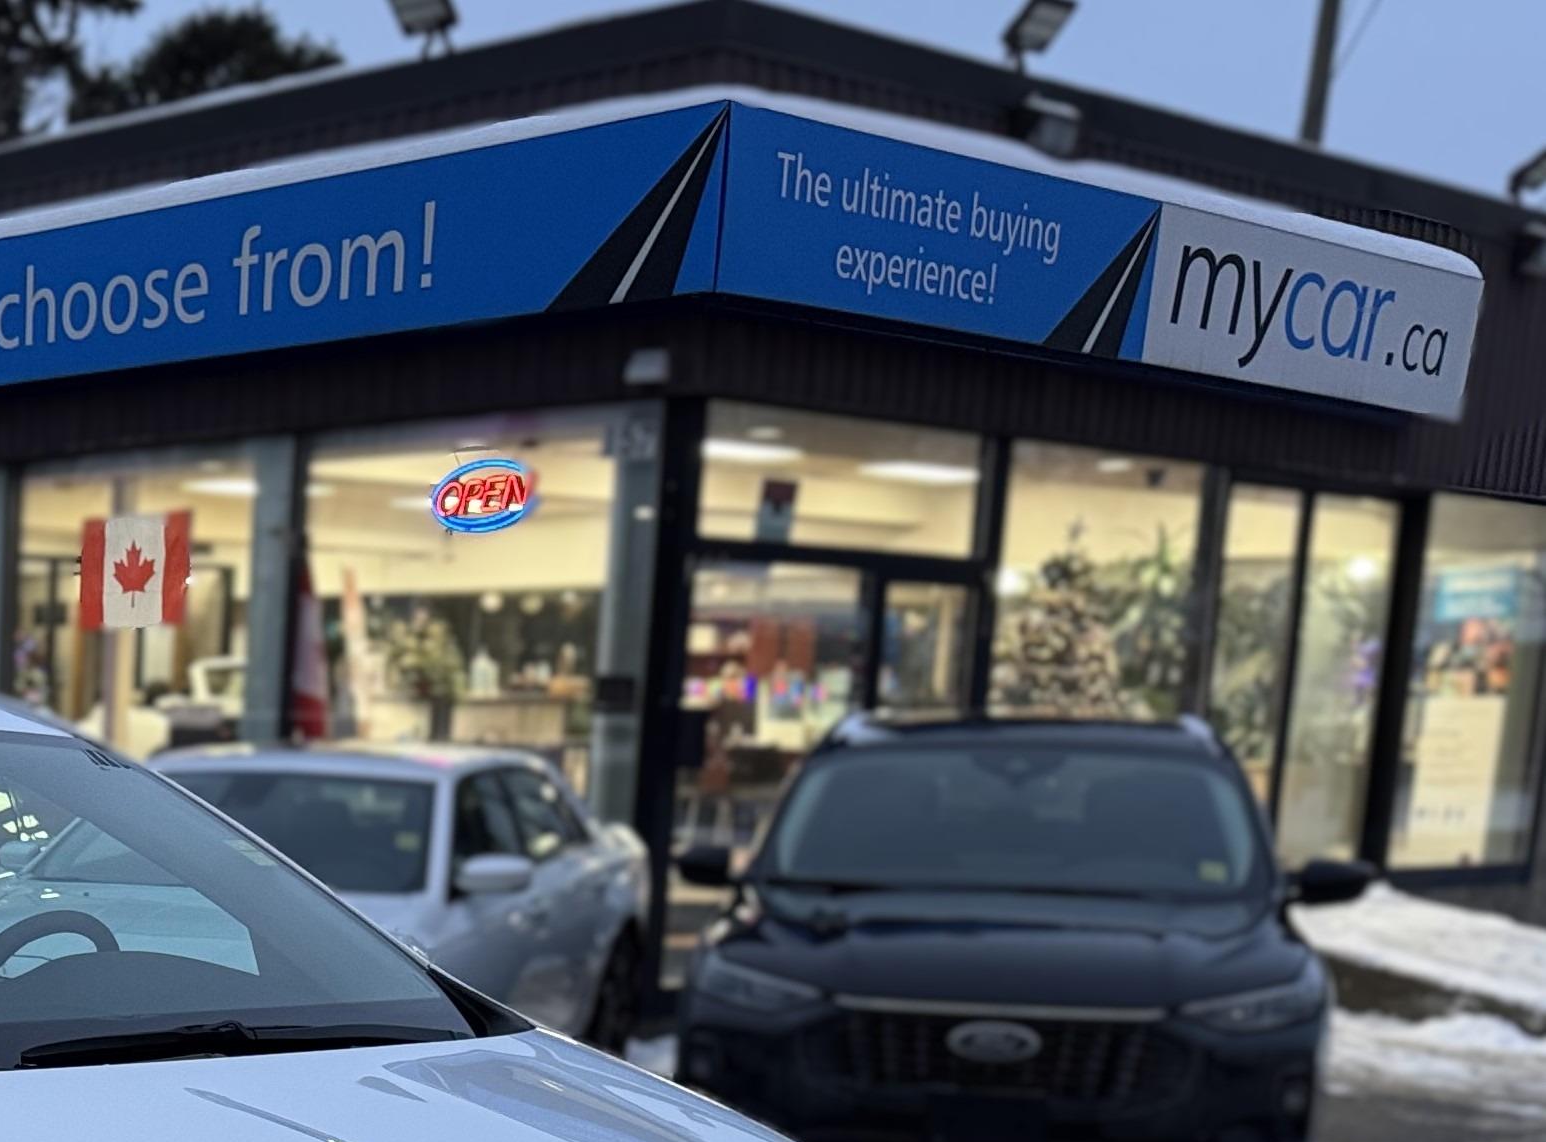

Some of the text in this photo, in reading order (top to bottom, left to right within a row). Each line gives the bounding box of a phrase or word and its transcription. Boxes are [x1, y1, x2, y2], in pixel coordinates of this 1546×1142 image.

[232, 200, 437, 316] from!
[777, 152, 1062, 265] The ultimate buying
[835, 245, 999, 304] experience!
[1168, 243, 1451, 378] mycar.ca
[435, 471, 535, 517] OPEN
